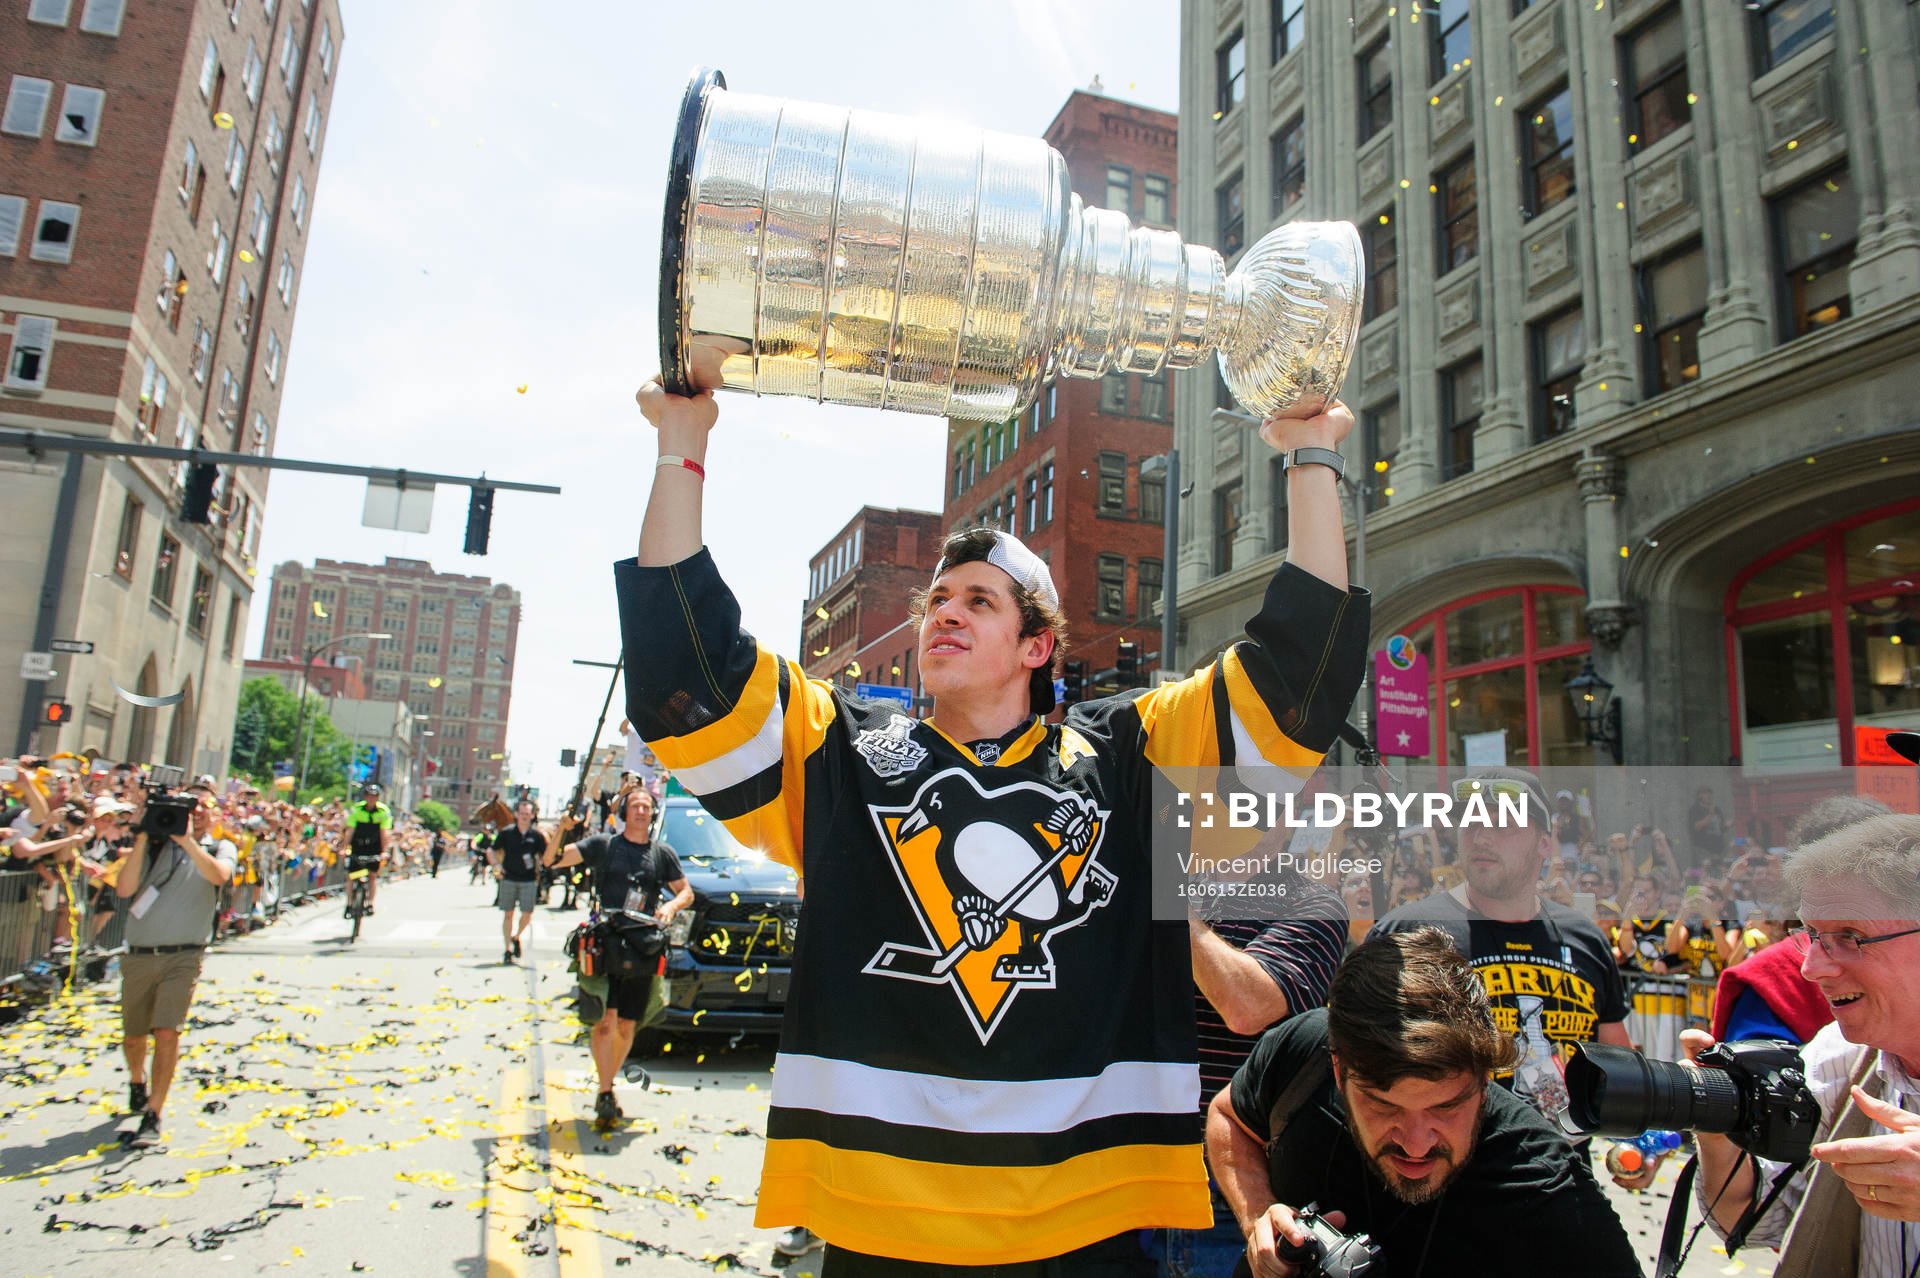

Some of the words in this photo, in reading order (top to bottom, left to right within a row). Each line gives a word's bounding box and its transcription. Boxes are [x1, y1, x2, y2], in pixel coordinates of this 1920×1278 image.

[1379, 674, 1396, 687] Art
[1379, 688, 1419, 702] Institute
[1379, 701, 1428, 719] Pittsburgh
[862, 735, 920, 760] FINAL
[980, 748, 996, 760] NHL
[1504, 941, 1533, 951] Reebok
